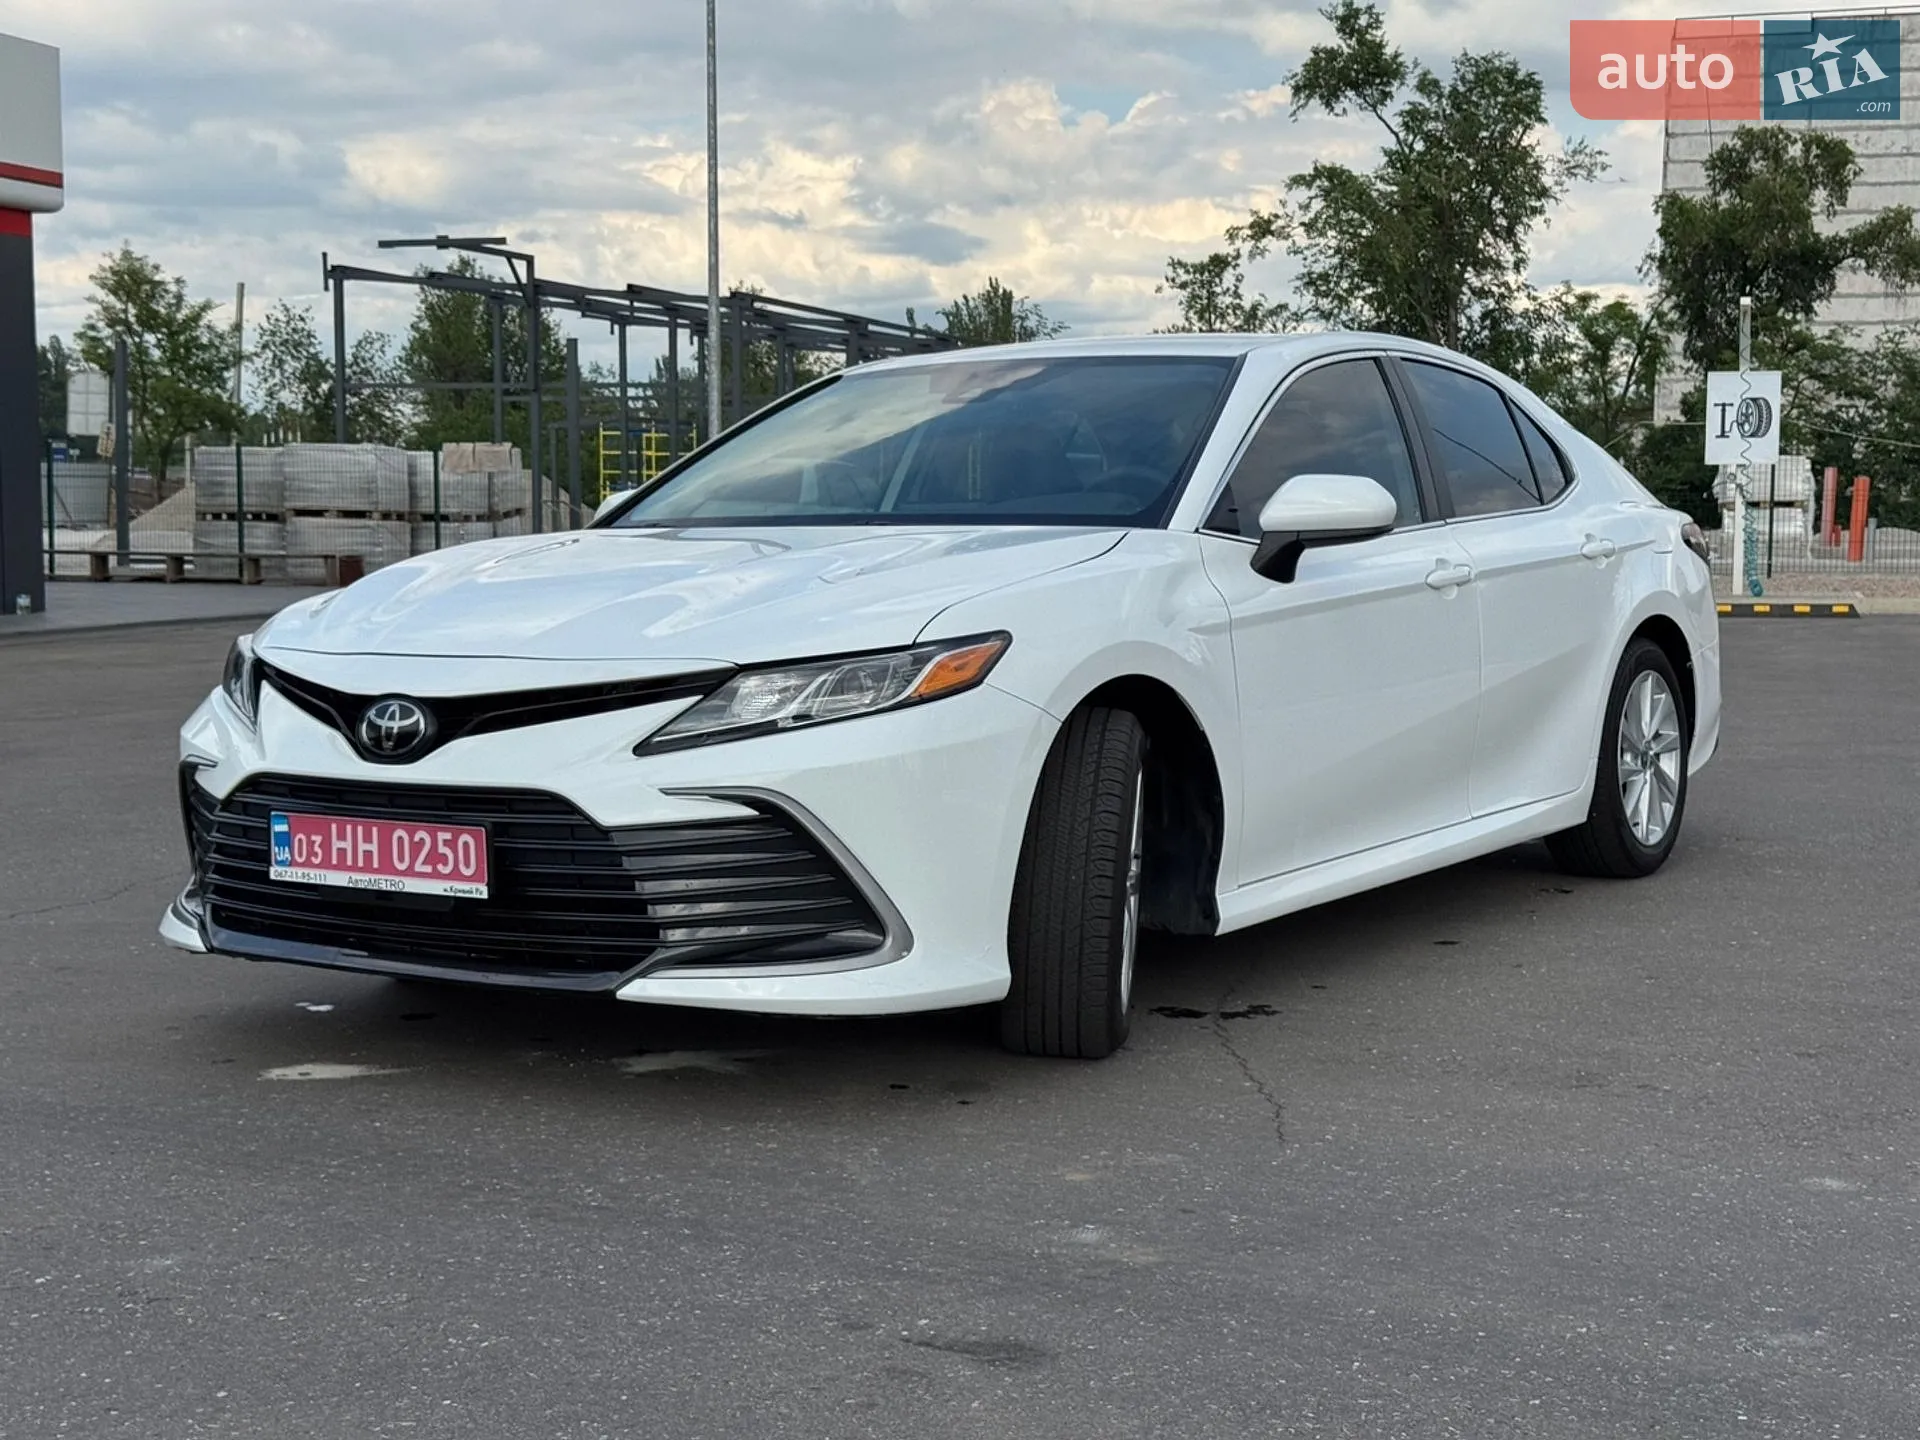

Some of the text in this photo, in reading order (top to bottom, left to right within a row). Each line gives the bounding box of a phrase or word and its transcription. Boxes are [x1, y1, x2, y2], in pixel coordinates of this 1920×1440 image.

[274, 846, 291, 862] UA
[294, 823, 477, 877] 03 HH 0250
